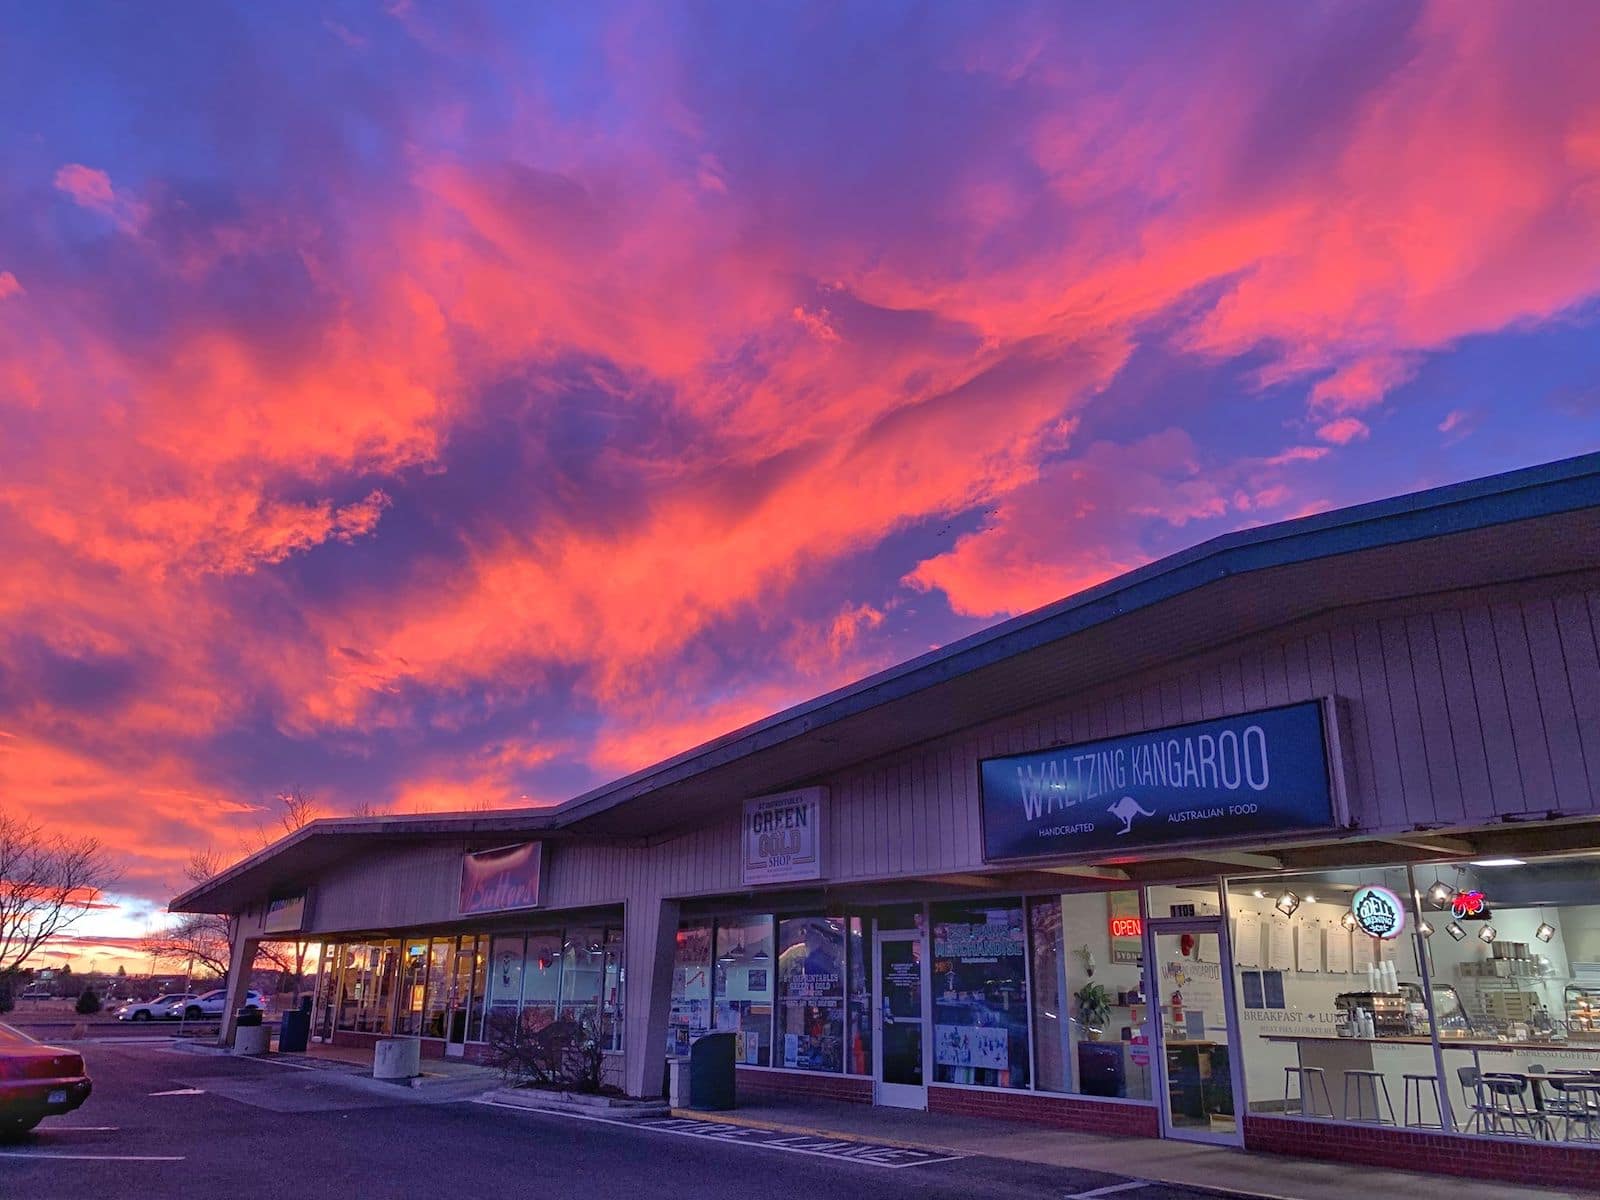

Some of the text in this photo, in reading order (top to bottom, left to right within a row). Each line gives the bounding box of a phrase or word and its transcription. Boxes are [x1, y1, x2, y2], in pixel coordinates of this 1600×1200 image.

[1017, 725, 1270, 821] WALTZING KANGAROO
[753, 804, 807, 833] GREEN
[1167, 803, 1257, 822] AUSTRALIAN FOOD
[1038, 822, 1095, 838] HANDCRAFTED
[768, 855, 791, 868] SHOP
[1360, 897, 1392, 918] ODELL
[1112, 919, 1142, 936] OPEN
[1244, 1010, 1303, 1023] BREAKFAST
[762, 1136, 929, 1161] LANE
